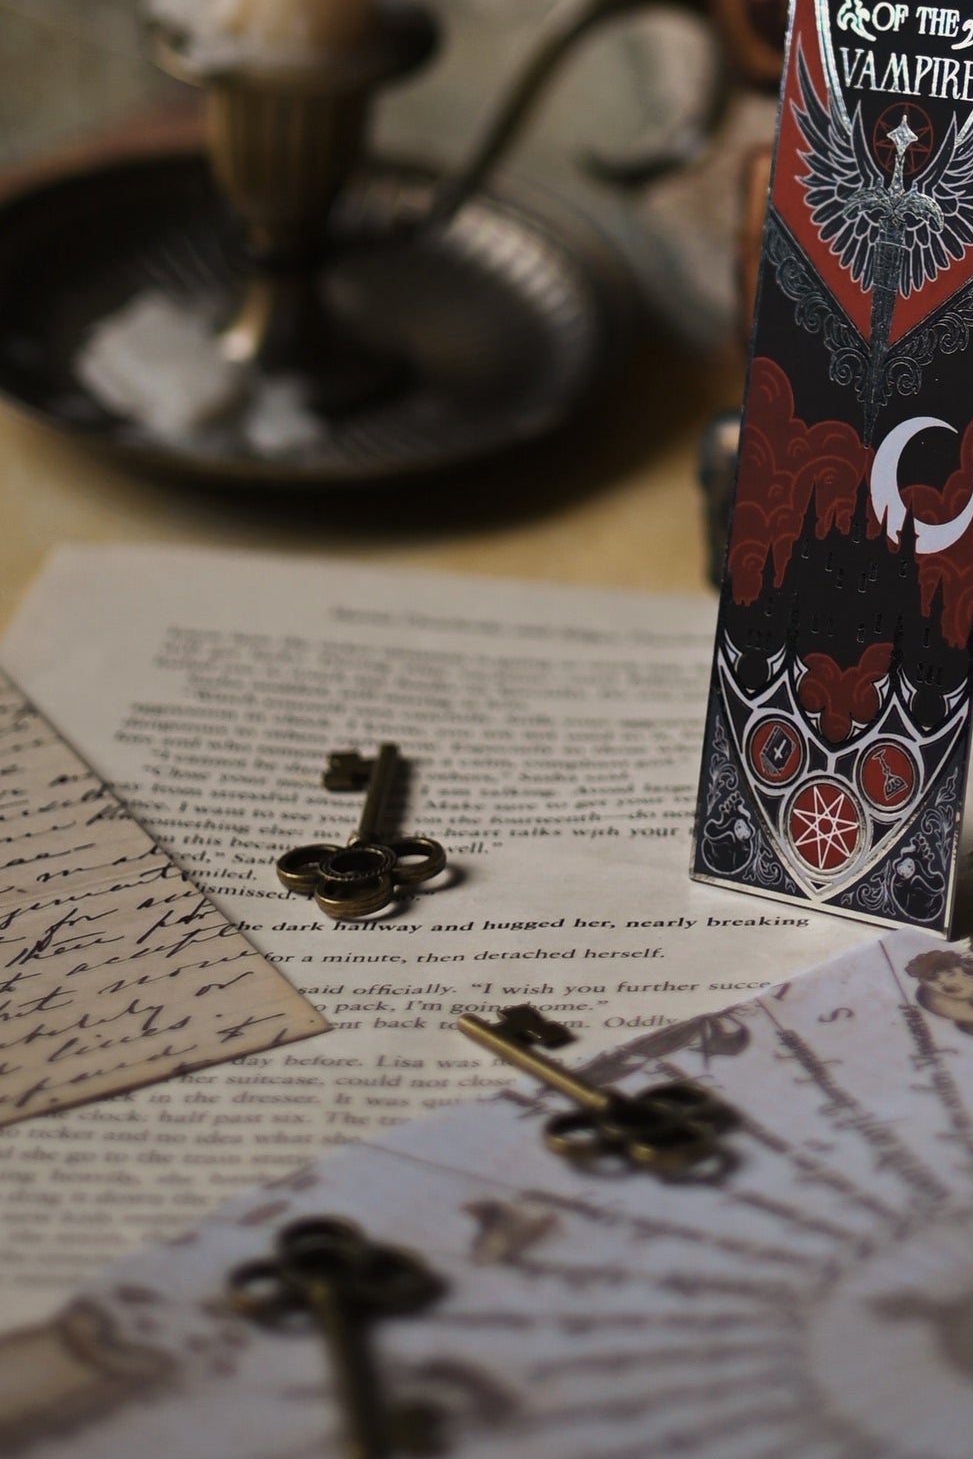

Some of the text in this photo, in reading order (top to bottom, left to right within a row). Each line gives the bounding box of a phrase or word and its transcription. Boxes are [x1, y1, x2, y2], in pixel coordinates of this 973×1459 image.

[872, 2, 960, 38] OF THE
[182, 834, 222, 846] this
[509, 827, 562, 838] talks
[627, 827, 679, 840] your
[271, 916, 811, 935] dark hallway and hugged her, nearly breaking
[301, 955, 313, 963] a
[323, 951, 407, 964] minute,
[416, 951, 465, 962] then
[473, 948, 576, 962] detached
[583, 948, 665, 960] herself.
[298, 984, 344, 995] said
[352, 984, 457, 995] officially.
[502, 983, 554, 995] wish
[564, 985, 613, 997] you
[616, 981, 700, 993] further
[333, 1000, 397, 1014] pack,
[405, 1000, 443, 1011] I’m
[373, 1018, 428, 1030] back
[231, 1054, 481, 1068] day before. Lisa was
[335, 1075, 402, 1087] could
[409, 1077, 449, 1088] not
[184, 1092, 222, 1104] the
[367, 1096, 410, 1107] was
[159, 1110, 210, 1123] half
